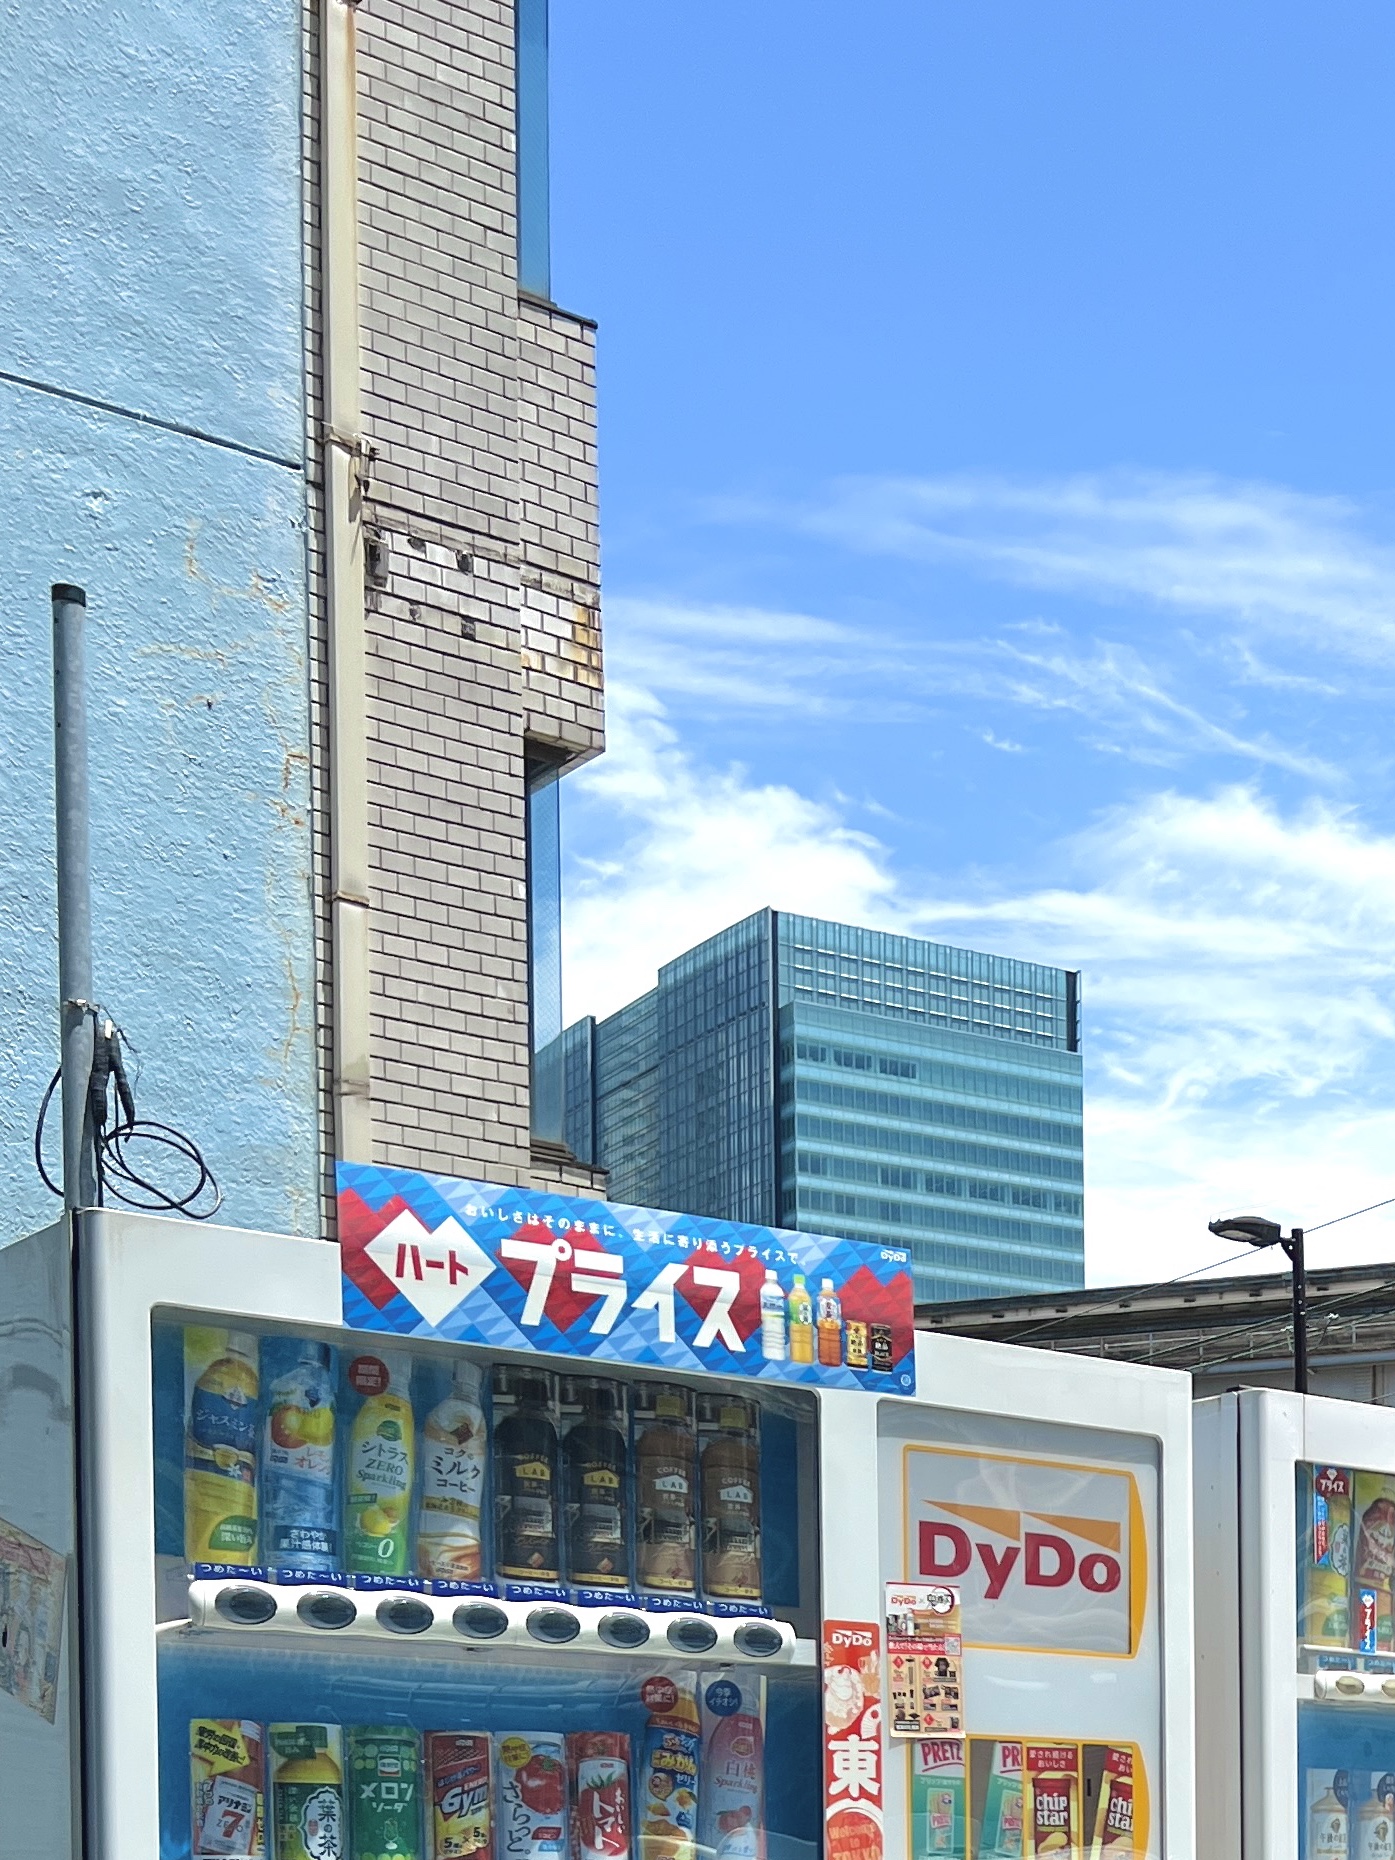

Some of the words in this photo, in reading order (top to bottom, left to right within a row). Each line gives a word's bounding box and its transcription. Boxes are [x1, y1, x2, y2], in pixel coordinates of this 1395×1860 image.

[396, 1243, 469, 1286] ハート
[501, 1239, 746, 1352] プライス
[361, 1441, 409, 1466] シトラス
[366, 1458, 404, 1477] ZERO
[429, 1456, 481, 1480] ミルク
[436, 1477, 476, 1494] コーヒー
[662, 1480, 684, 1491] LAB
[727, 1490, 749, 1500] LAB
[378, 1539, 395, 1558] 0
[919, 1520, 1121, 1600] DyDo
[832, 1633, 873, 1648] DyDo
[828, 1735, 880, 1798] 東
[1037, 1760, 1067, 1769] おいしさ
[359, 1782, 414, 1801] メロン
[1036, 1792, 1068, 1809] chip
[216, 1795, 252, 1814] アリナミン
[372, 1802, 408, 1813] ソーダ
[221, 1810, 245, 1839] 7
[592, 1790, 620, 1850] トマト
[1036, 1808, 1069, 1826] star
[317, 1799, 338, 1858] 葉の茶
